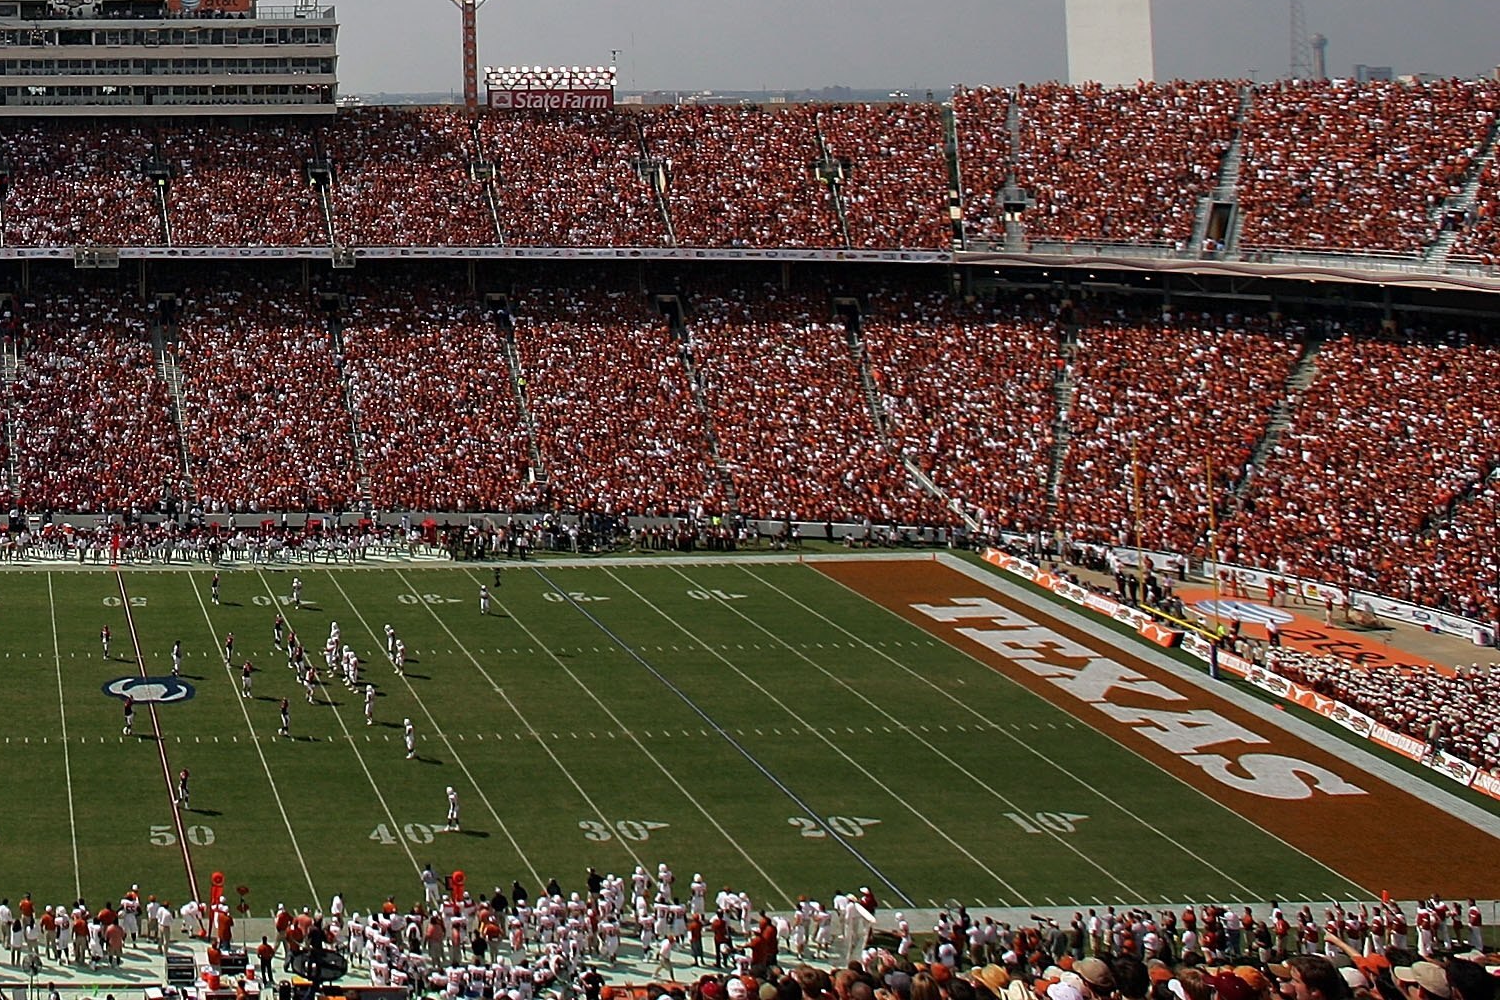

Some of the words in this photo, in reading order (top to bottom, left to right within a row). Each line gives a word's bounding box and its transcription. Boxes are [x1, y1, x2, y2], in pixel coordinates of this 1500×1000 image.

[514, 91, 561, 109] State
[562, 91, 608, 109] Farm
[908, 597, 1370, 800] TEXAS
[577, 819, 649, 842] 30
[787, 816, 864, 838] 20
[1002, 811, 1076, 834] 10
[149, 825, 216, 847] 50
[367, 823, 437, 846] 40
